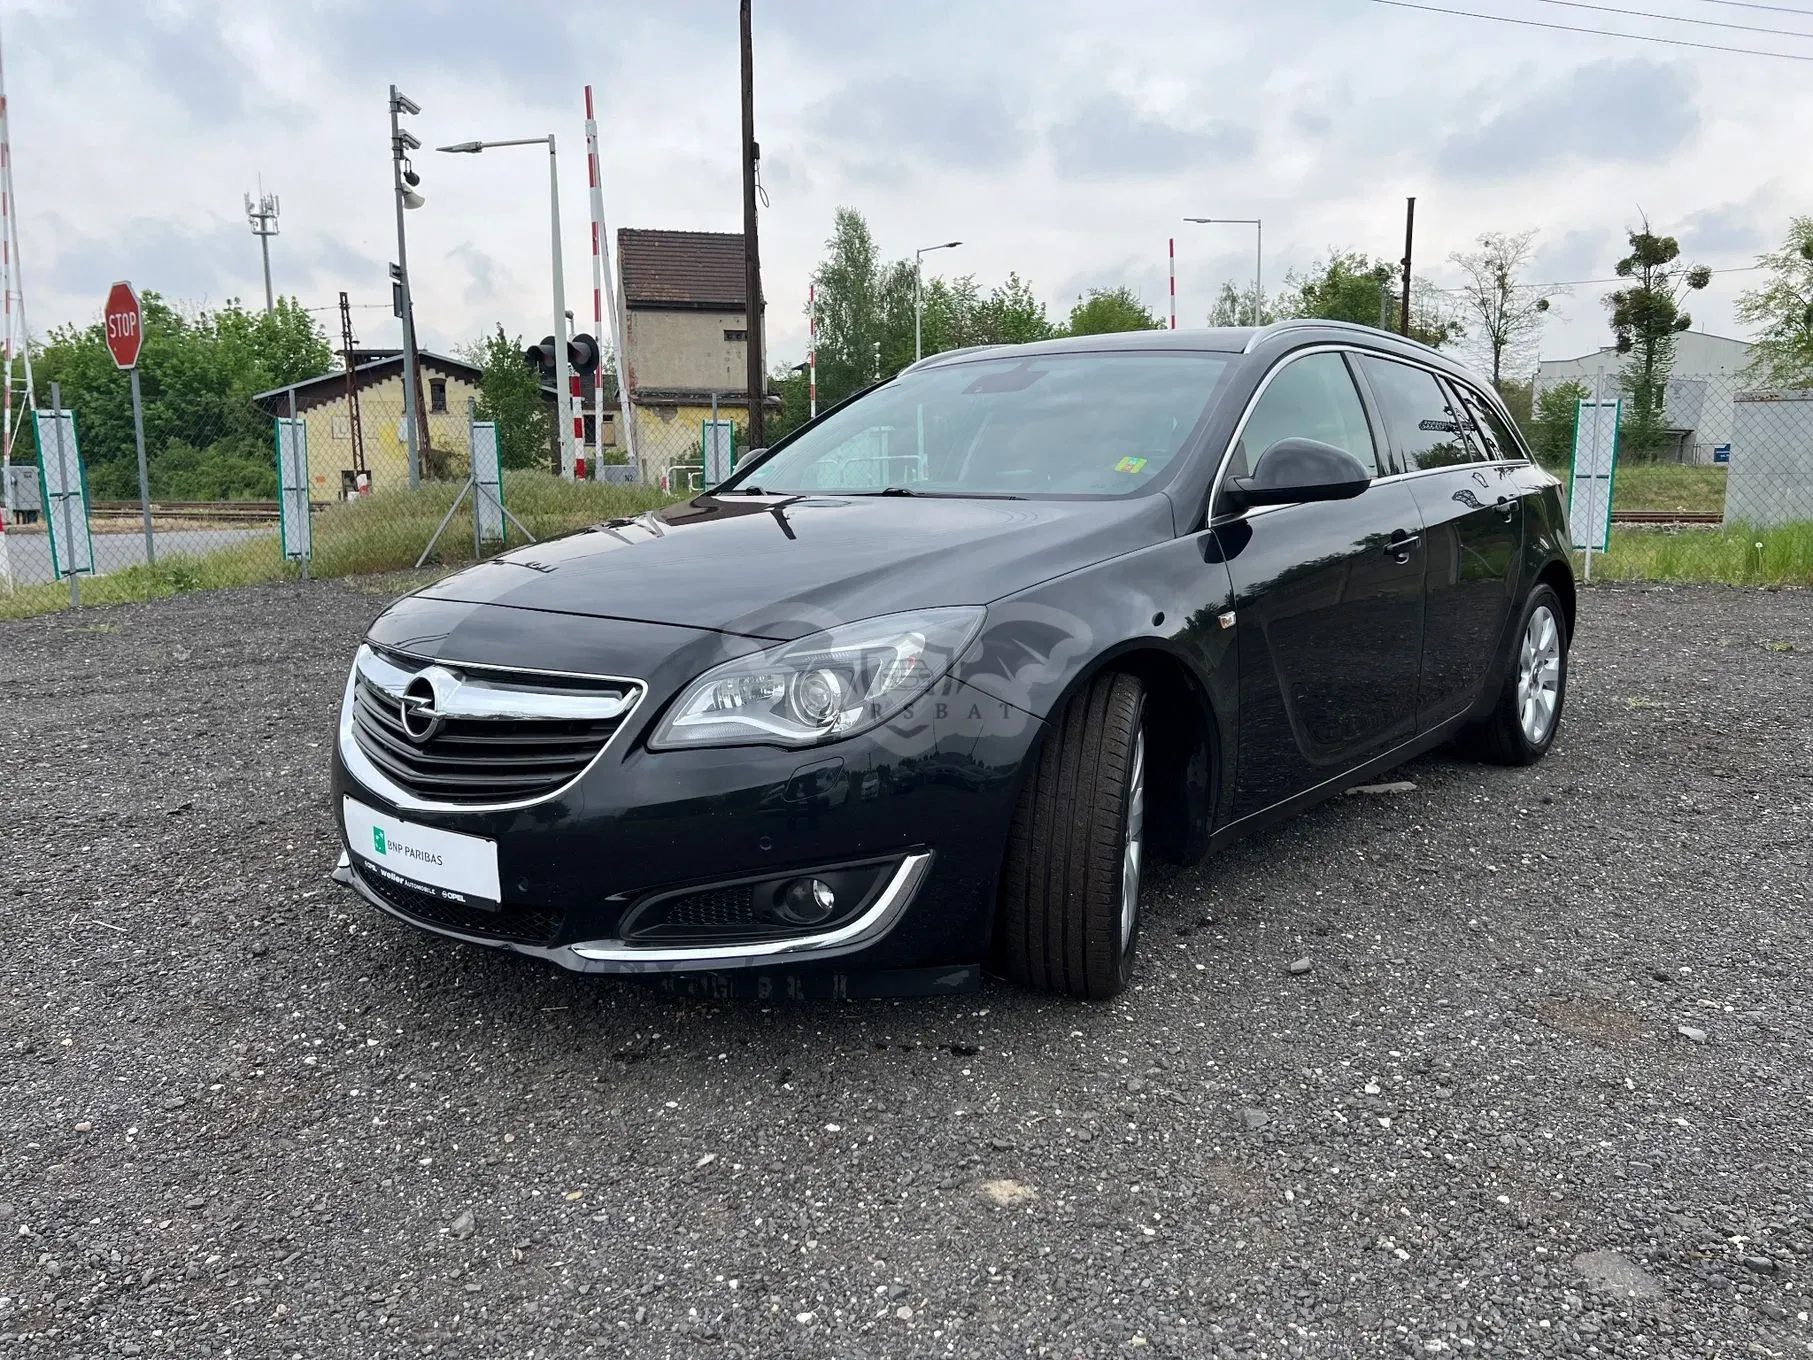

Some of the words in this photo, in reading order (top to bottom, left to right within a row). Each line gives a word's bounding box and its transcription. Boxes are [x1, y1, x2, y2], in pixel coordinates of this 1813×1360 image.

[109, 311, 137, 338] STOP
[387, 840, 403, 853] BNP
[405, 846, 443, 865] PARIBAS
[380, 869, 404, 884] weller
[447, 892, 466, 902] OPEL
